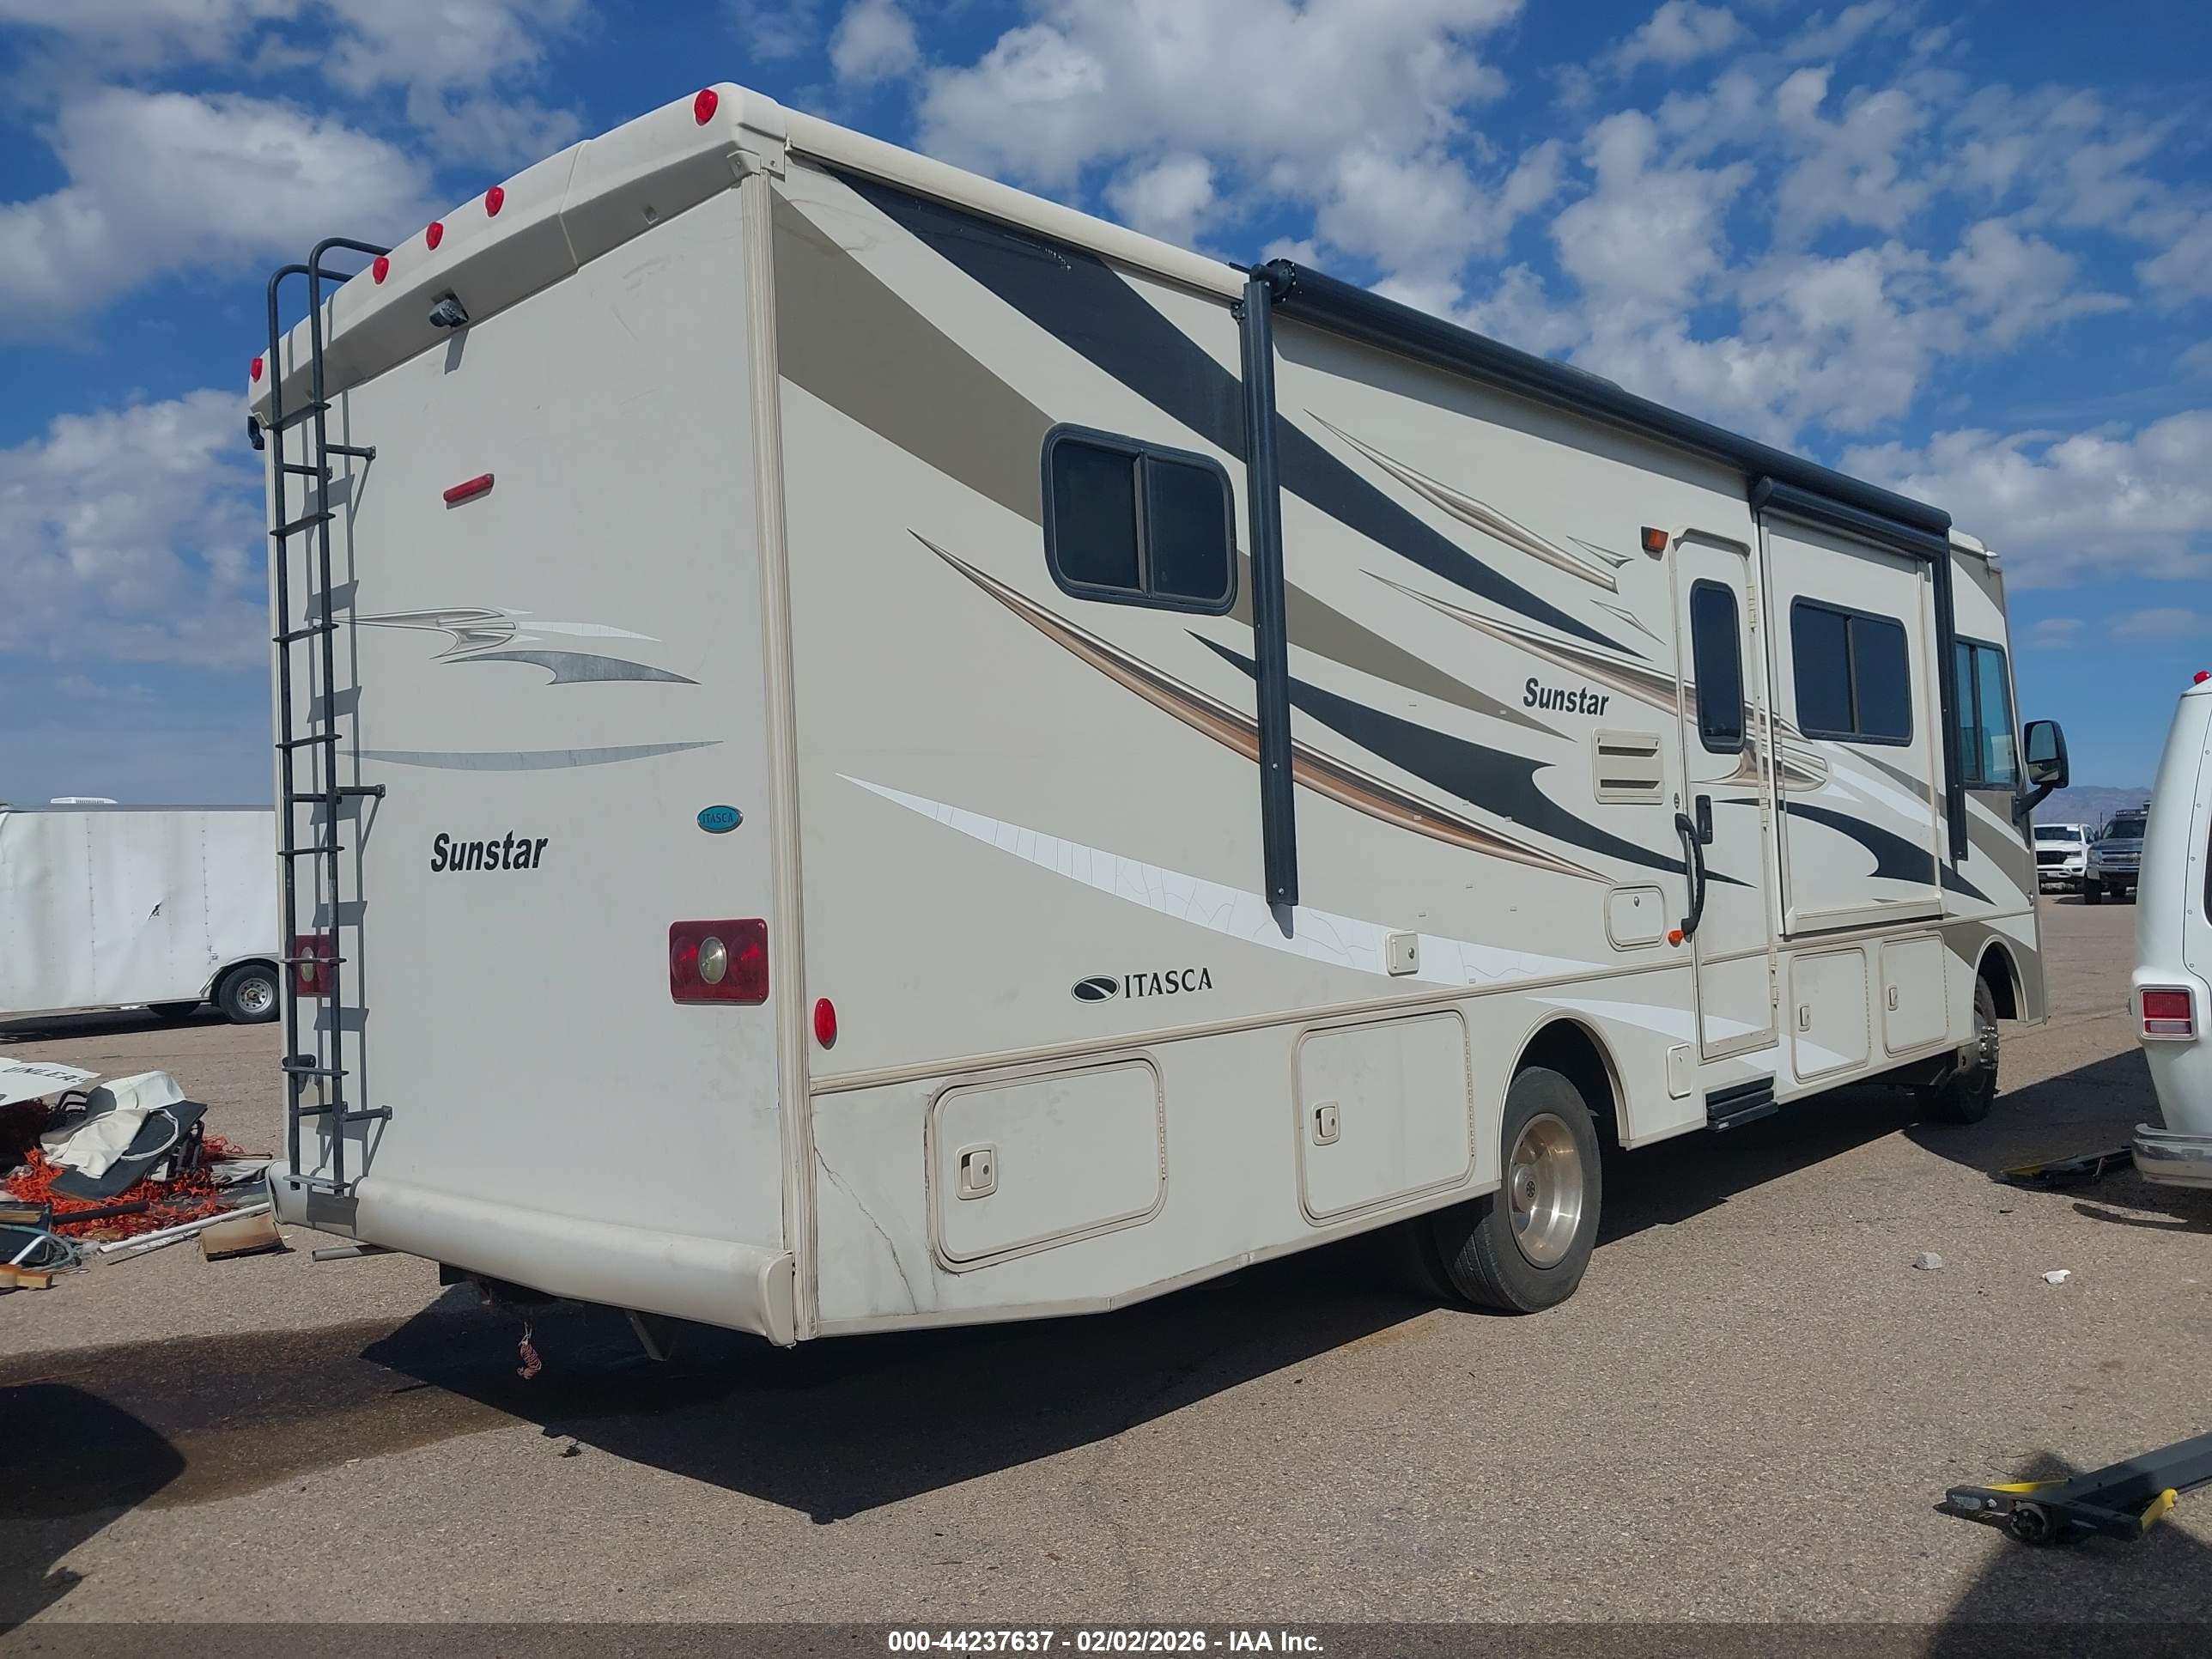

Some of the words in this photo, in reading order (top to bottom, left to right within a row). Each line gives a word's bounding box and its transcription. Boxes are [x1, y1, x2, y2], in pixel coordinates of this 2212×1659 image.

[1522, 677, 1610, 716] Sunstar
[701, 811, 734, 824] ITASCA
[430, 830, 550, 872] Sunstar
[1124, 967, 1213, 999] ITASCA
